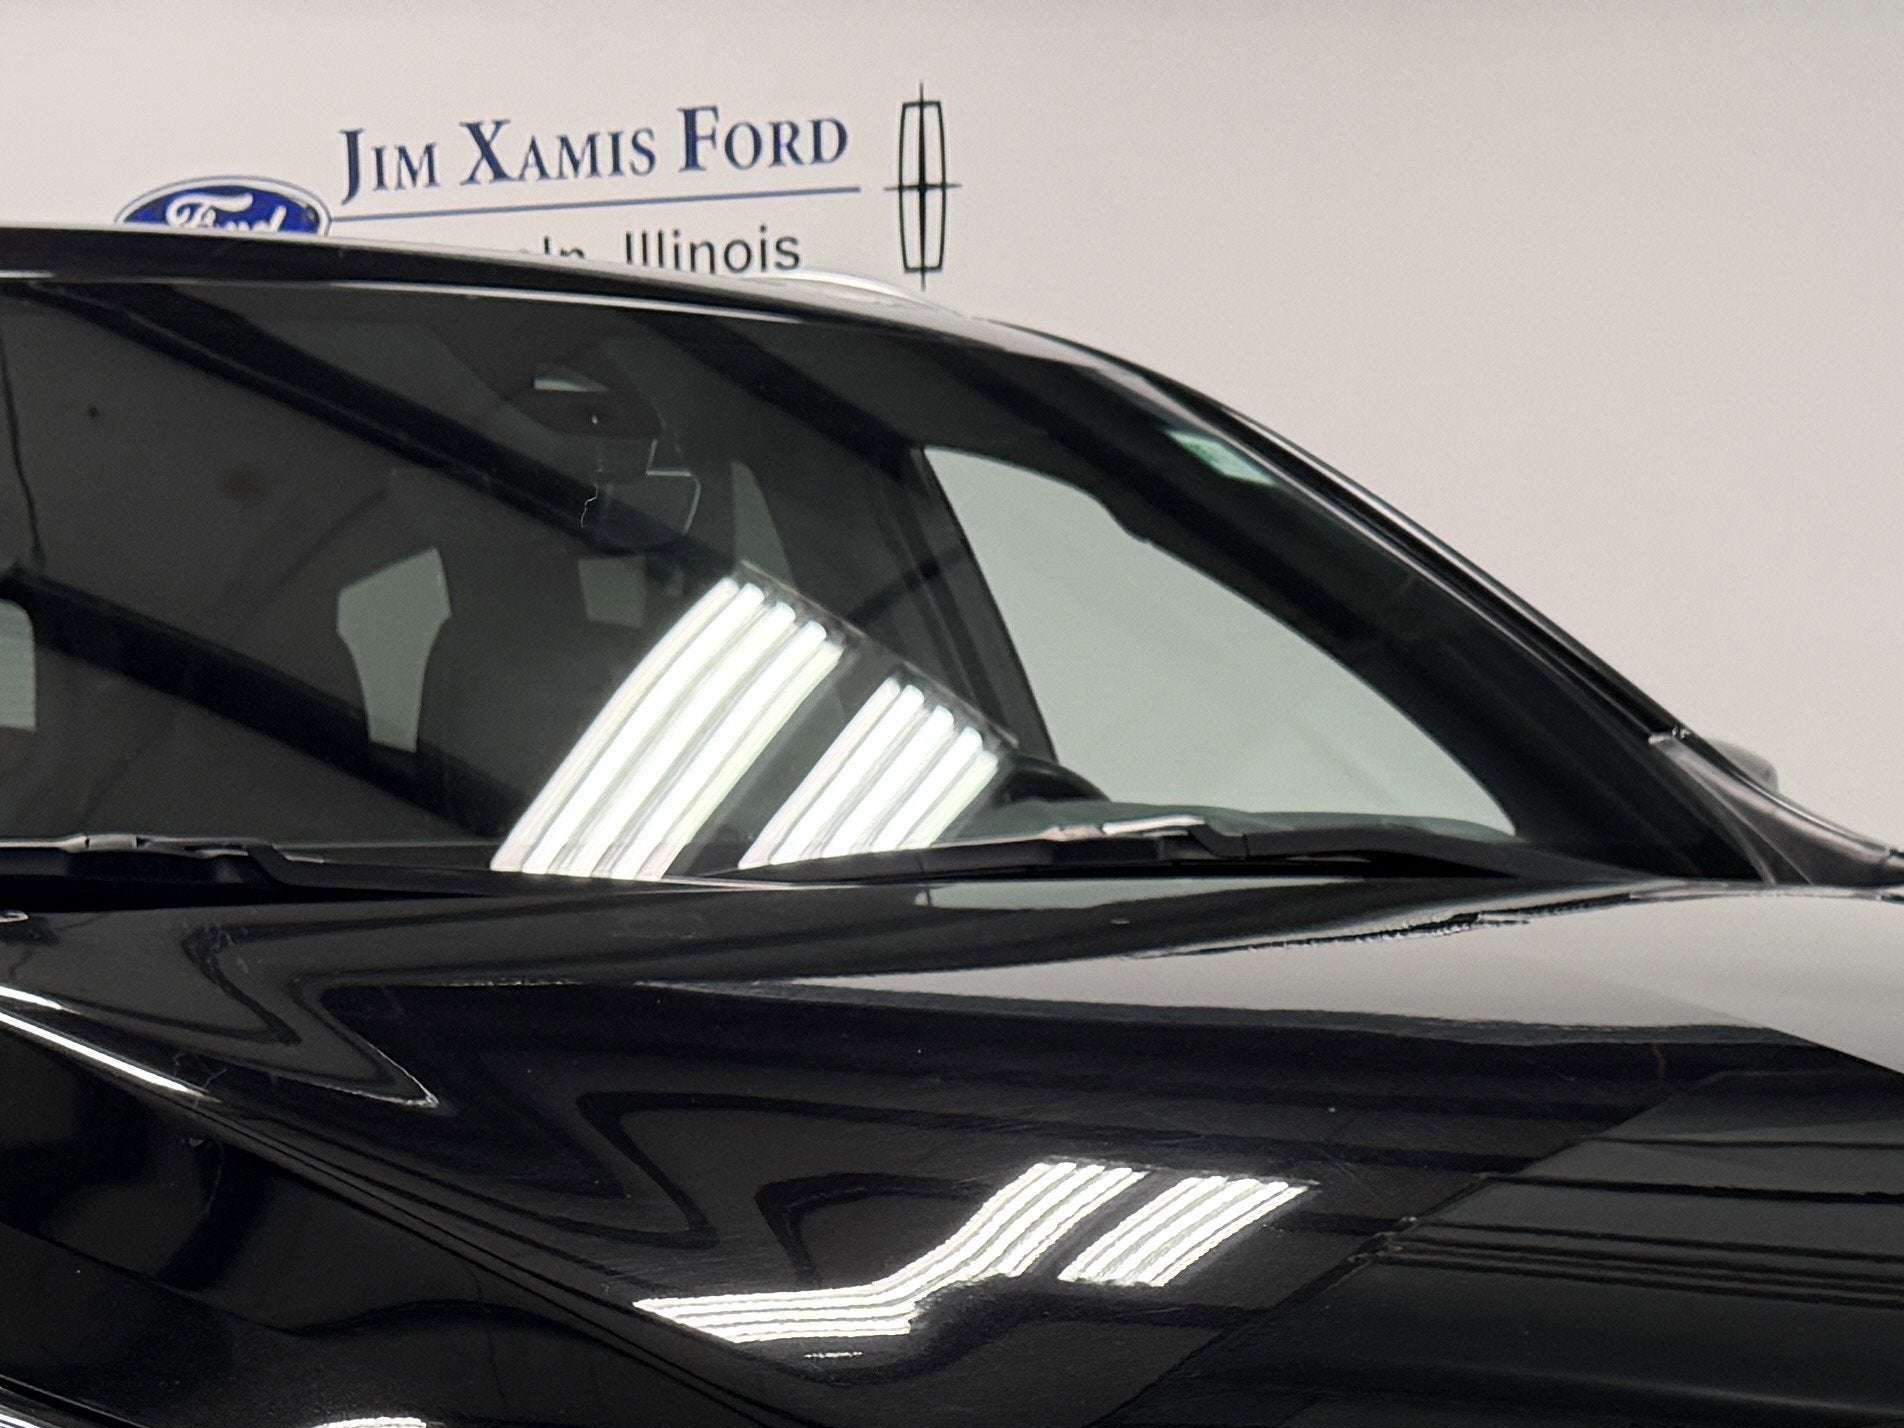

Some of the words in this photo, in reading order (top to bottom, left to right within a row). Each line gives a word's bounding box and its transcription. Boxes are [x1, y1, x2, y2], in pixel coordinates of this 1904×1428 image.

[338, 128, 440, 206] JIM
[459, 118, 657, 187] XAMIS
[677, 105, 848, 173] FORD
[625, 224, 800, 274] Illinois
